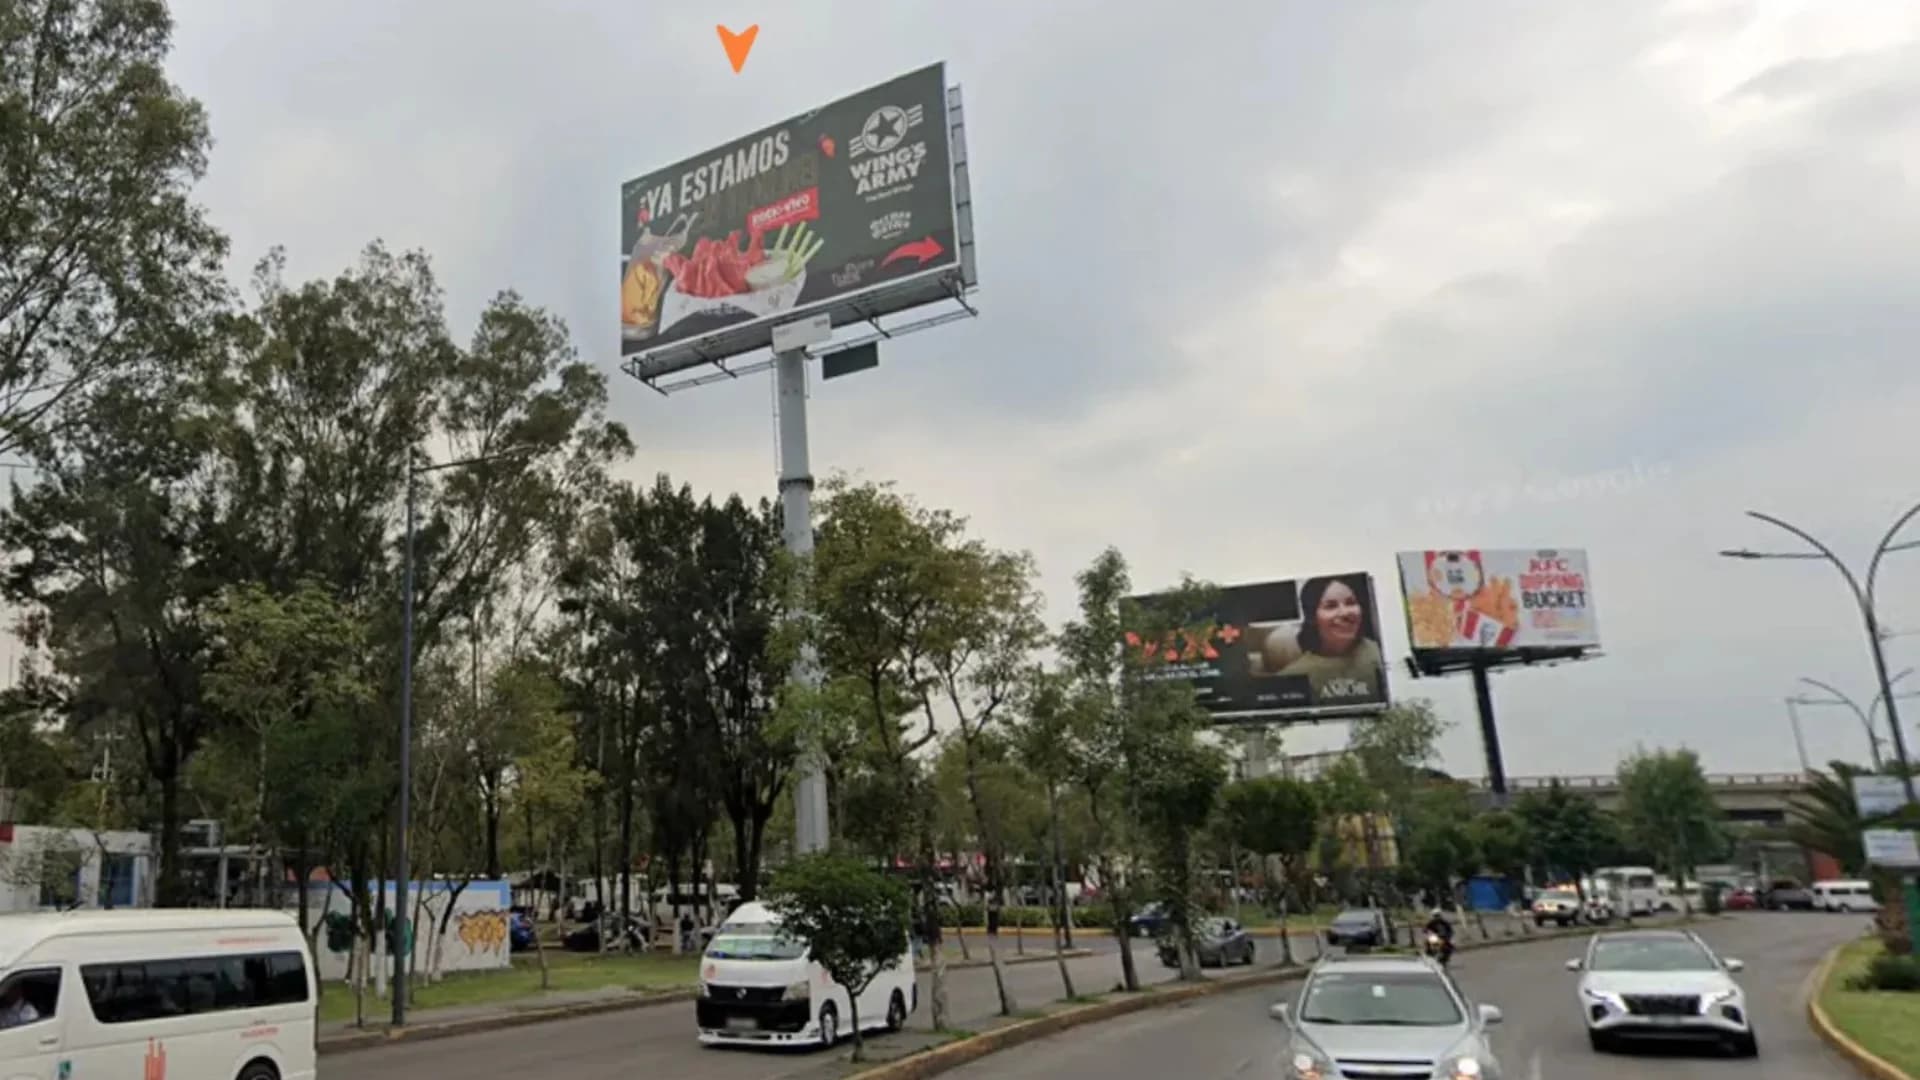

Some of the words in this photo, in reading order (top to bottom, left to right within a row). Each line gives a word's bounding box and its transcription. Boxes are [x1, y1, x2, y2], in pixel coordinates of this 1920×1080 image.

[679, 129, 790, 208] ESTAMOS
[855, 159, 922, 195] ARMY
[1529, 559, 1569, 572] KFC
[1522, 591, 1586, 608] BUCKET
